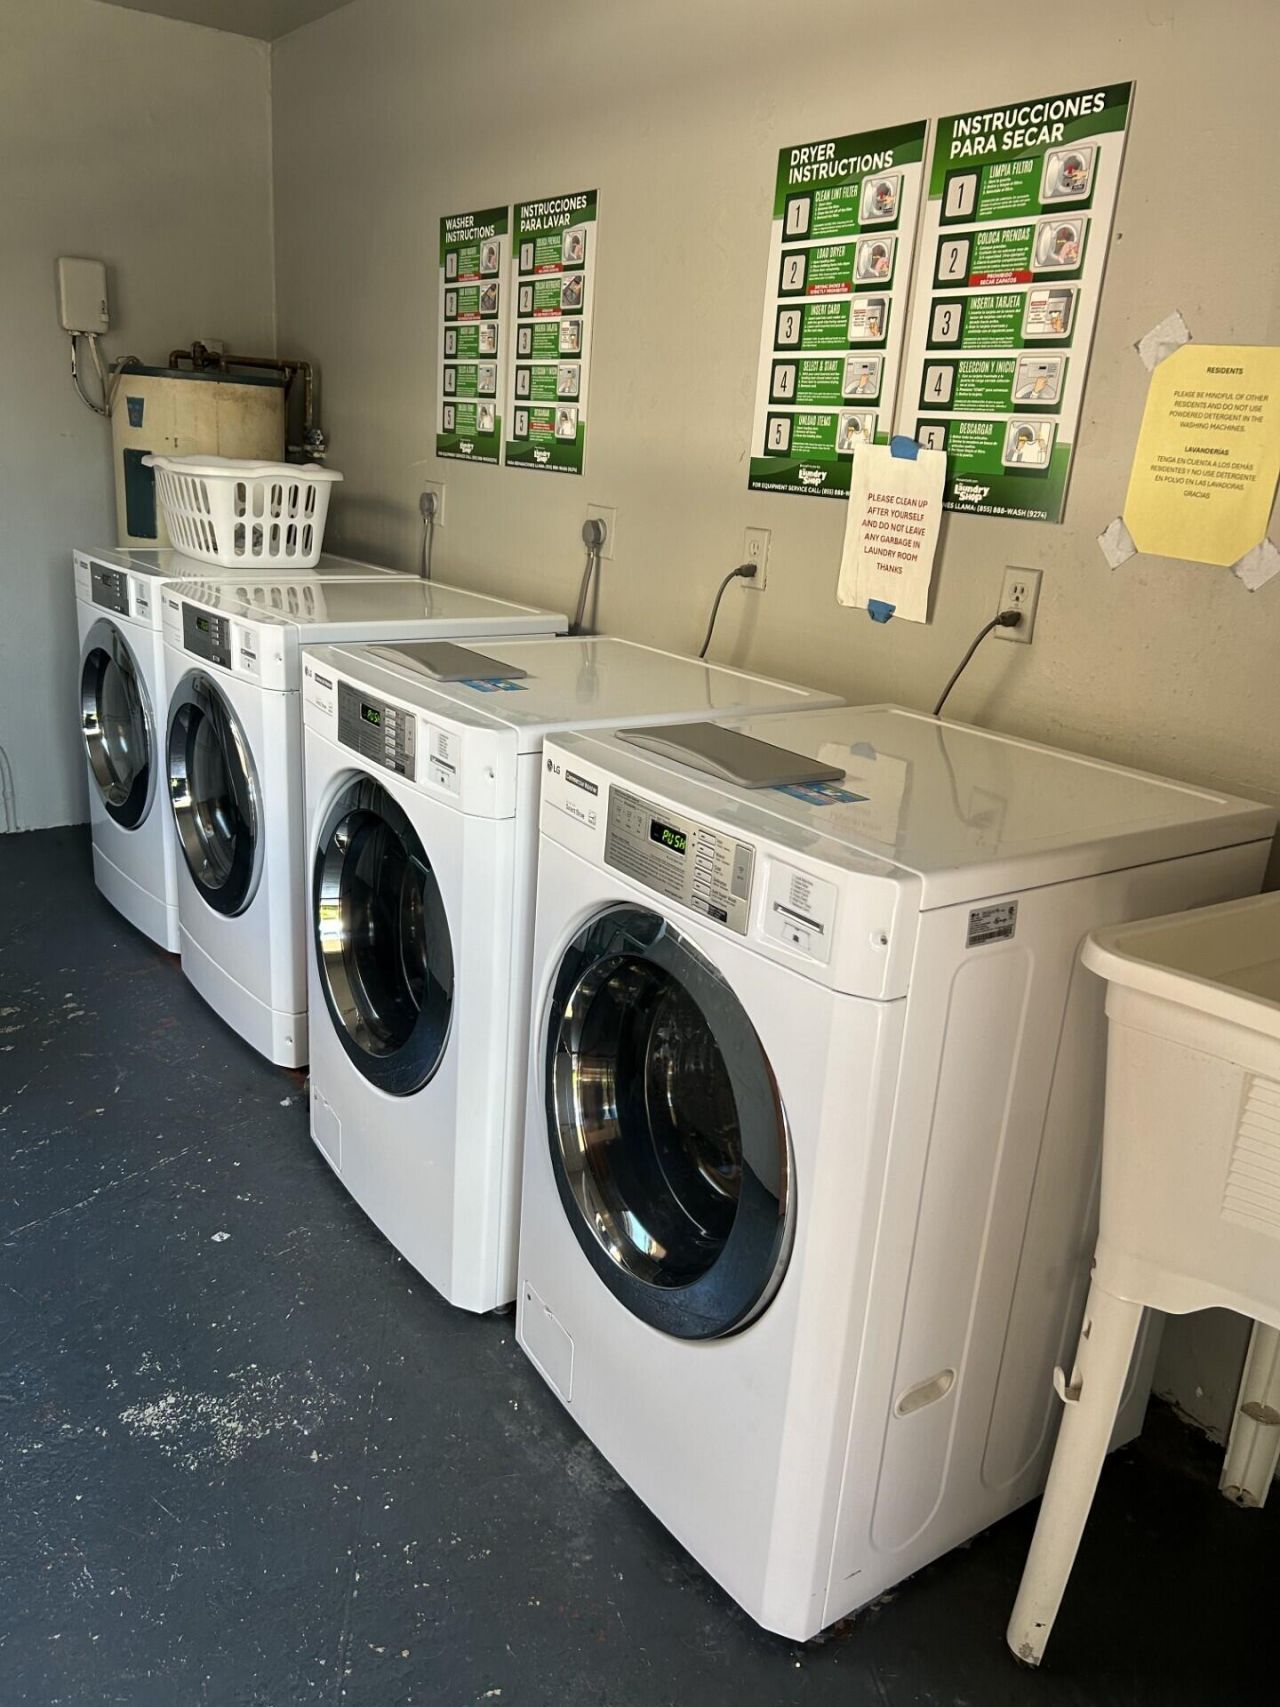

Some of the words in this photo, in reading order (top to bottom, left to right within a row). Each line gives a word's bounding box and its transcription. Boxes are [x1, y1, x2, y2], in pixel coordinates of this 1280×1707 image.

[953, 93, 1105, 138] INSTRUCCIONES
[950, 134, 997, 159] PARA
[1002, 123, 1064, 150] SECAR
[791, 143, 835, 166] DRYER
[789, 150, 894, 184] INSTRUCTIONS
[990, 162, 1011, 178] LIMPIA
[1012, 160, 1033, 176] FILTRO
[815, 190, 830, 202] CLEAN
[959, 182, 964, 208] 1
[521, 196, 587, 218] INSTRUCCIONES
[446, 216, 474, 230] WASHER
[521, 218, 541, 232] PARA
[544, 213, 570, 228] LAVAR
[796, 204, 800, 228] 1
[446, 225, 494, 243] INSTRUCTIONS
[830, 246, 845, 257] DRYER
[949, 248, 958, 273] 2
[791, 261, 797, 284] 2
[995, 295, 1020, 308] TARJETA
[786, 316, 792, 338] 3
[942, 310, 950, 335] 3
[959, 360, 989, 373] SELECCION
[991, 361, 995, 373] Y
[1207, 366, 1243, 375] RESIDENTS
[781, 371, 787, 392] 4
[934, 372, 942, 396] 4
[1204, 412, 1242, 421] DETERGENT
[776, 424, 781, 444] 5
[1186, 458, 1212, 467] CUENTA
[1150, 465, 1186, 474] RESIDENTES
[1216, 471, 1257, 481] DETERGENTE
[1164, 476, 1184, 484] POLVO
[954, 482, 990, 496] Laundry
[1184, 490, 1210, 499] GRACIAS
[868, 493, 894, 503] PLEASE
[896, 496, 917, 506] CLEAN
[867, 506, 889, 516] AFTER
[891, 510, 924, 522] YOURSELF
[977, 505, 992, 513] (855)
[993, 506, 1026, 516] 888-WASH
[1027, 510, 1047, 519] (9274)
[862, 519, 878, 528] AND
[878, 521, 889, 530] DO
[891, 523, 904, 533] NOT
[906, 526, 926, 536] LEAVE
[880, 535, 912, 548] GARBAGE
[913, 541, 920, 549] IN
[864, 546, 896, 558] LAUNDRY
[897, 552, 918, 562] ROOM
[877, 562, 903, 575] THANKS
[553, 764, 561, 775] LG
[662, 829, 686, 850] PUSH
